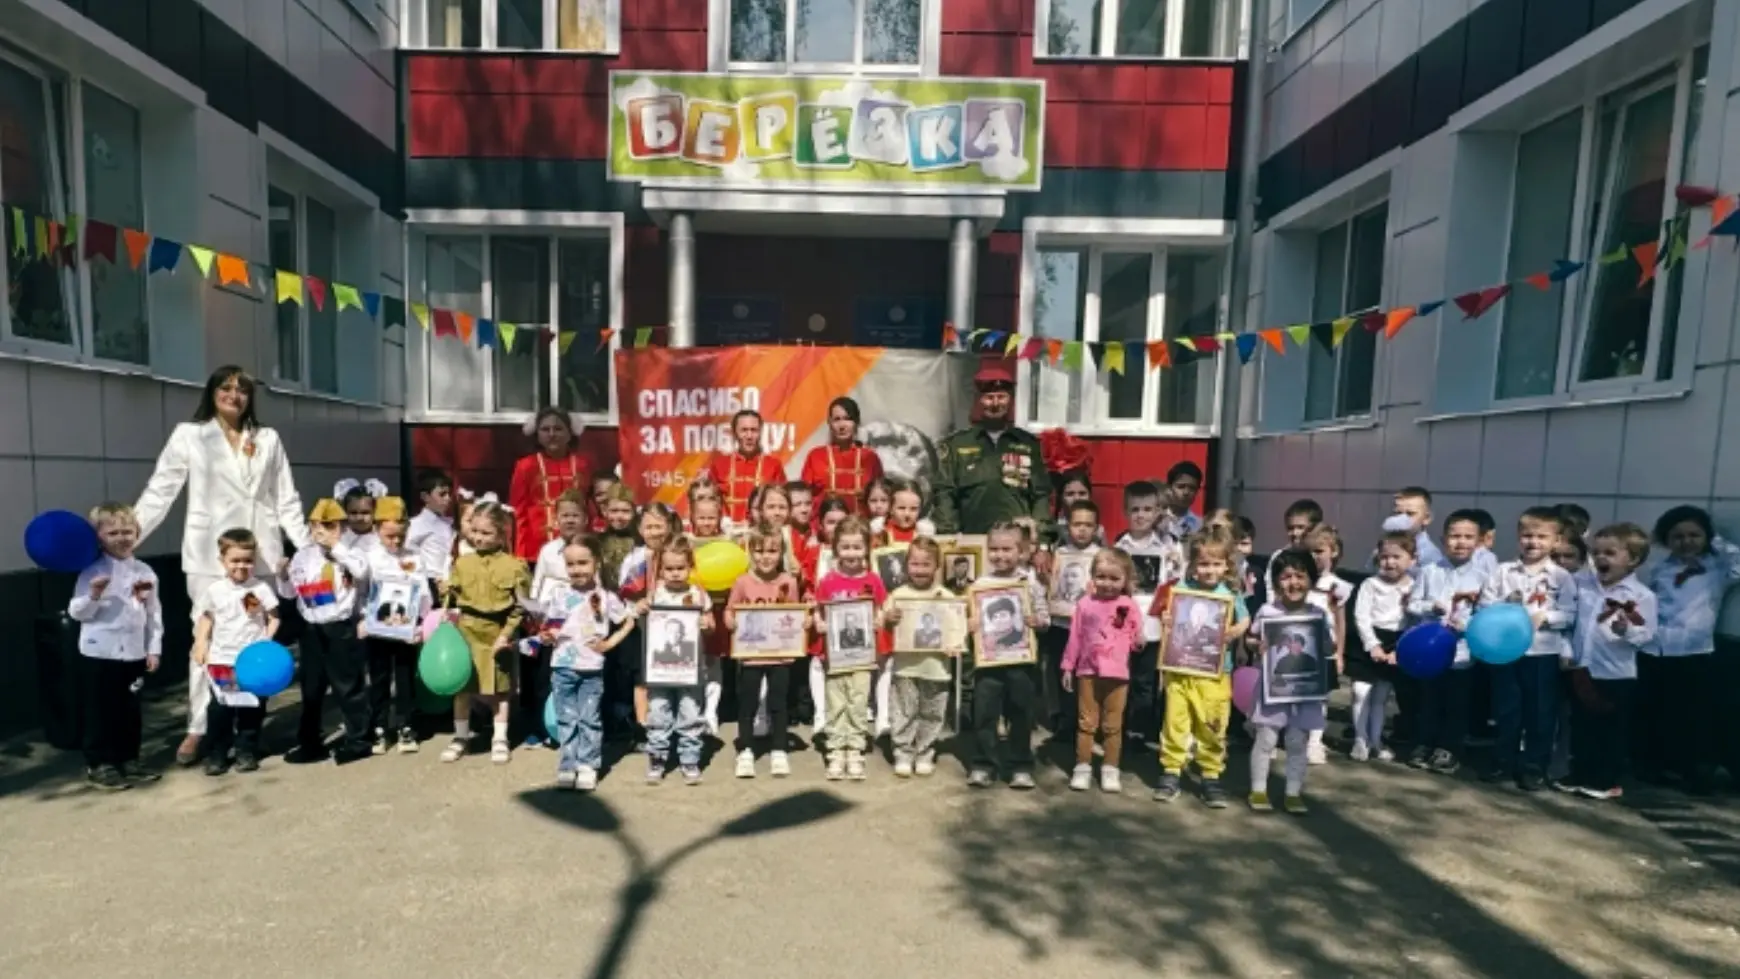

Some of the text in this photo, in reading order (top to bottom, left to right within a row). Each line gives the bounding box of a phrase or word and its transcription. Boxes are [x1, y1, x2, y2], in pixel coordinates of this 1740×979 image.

[640, 104, 1015, 162] БЕРЁЗКА
[638, 387, 759, 417] СПАСИБО
[640, 423, 795, 454] ЗА ПОБУ!
